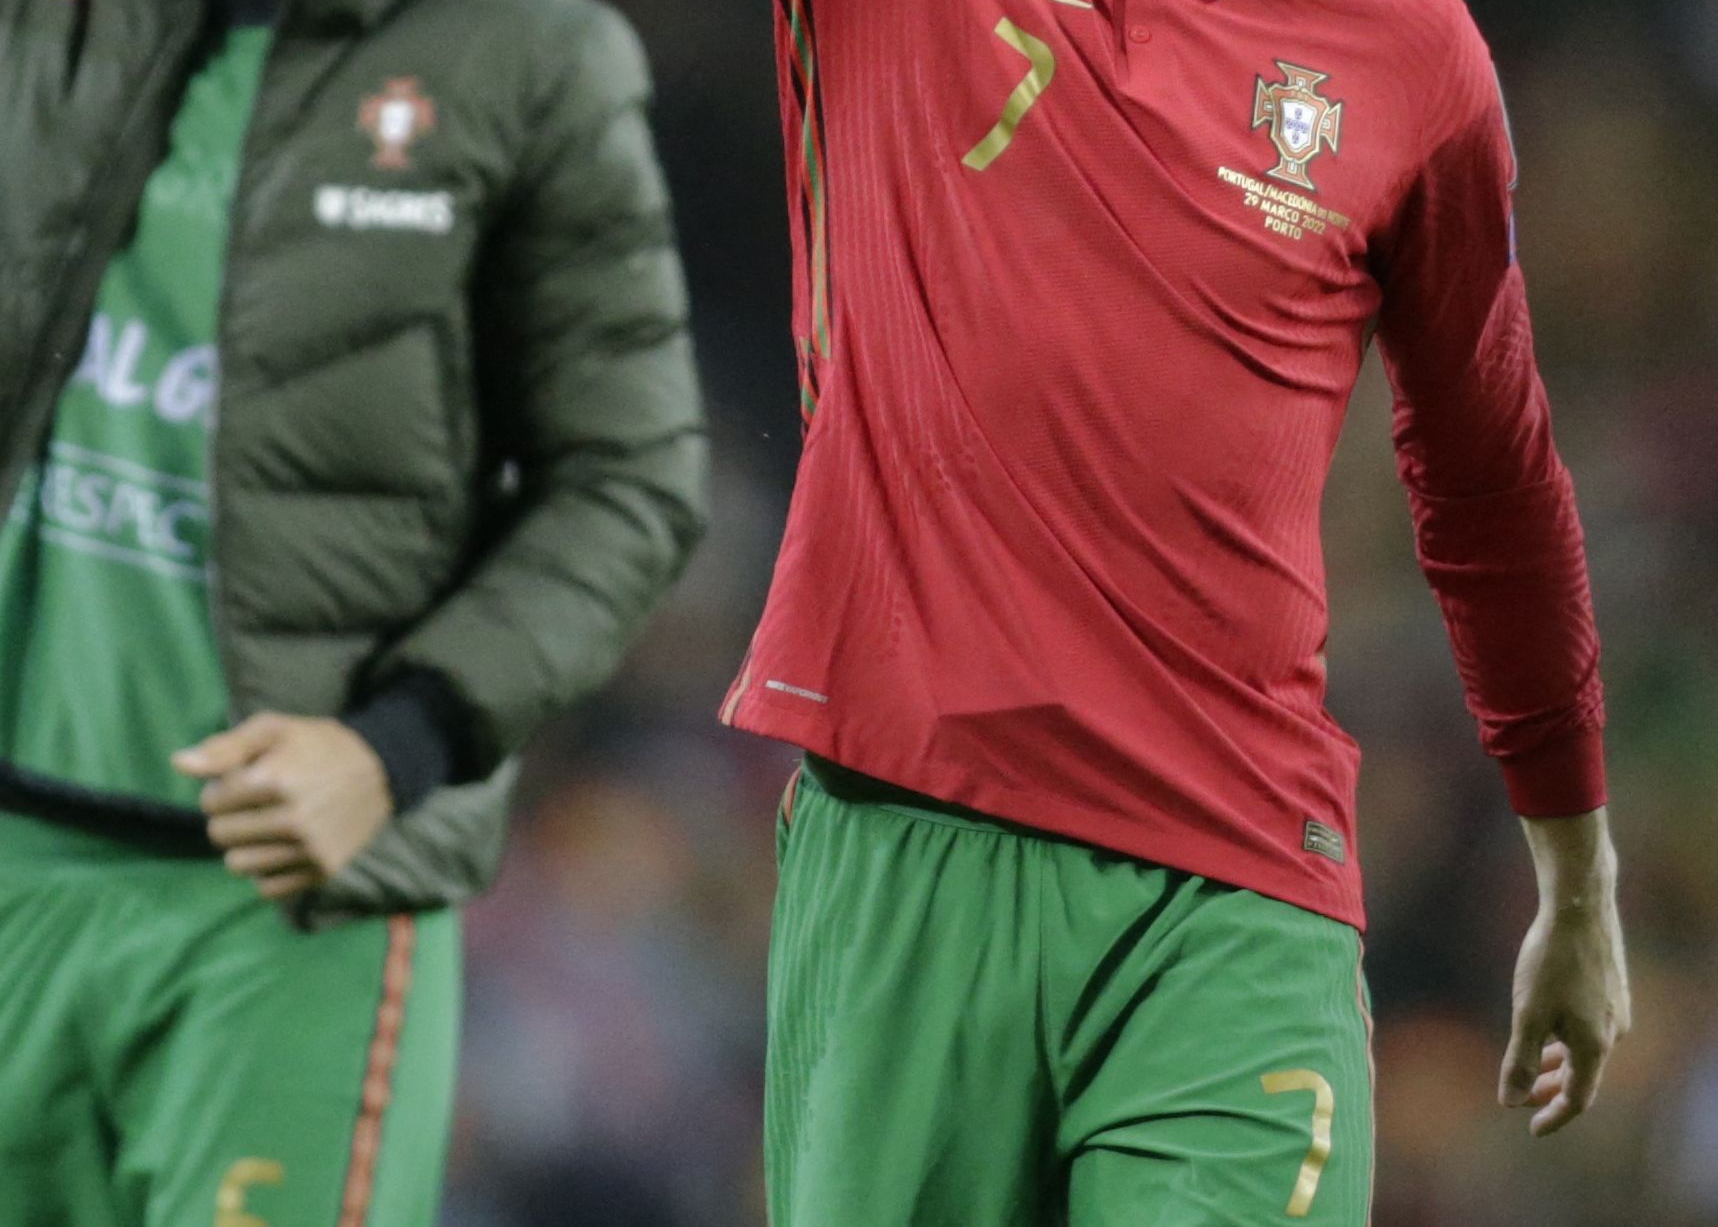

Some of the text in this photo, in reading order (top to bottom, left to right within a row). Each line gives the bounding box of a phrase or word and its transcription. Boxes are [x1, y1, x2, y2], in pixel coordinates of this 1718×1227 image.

[962, 16, 1056, 172] 7
[1244, 192, 1259, 206] 29
[1302, 215, 1326, 234] 2022
[1265, 217, 1302, 240] PORTO
[1260, 1069, 1334, 1217] 7
